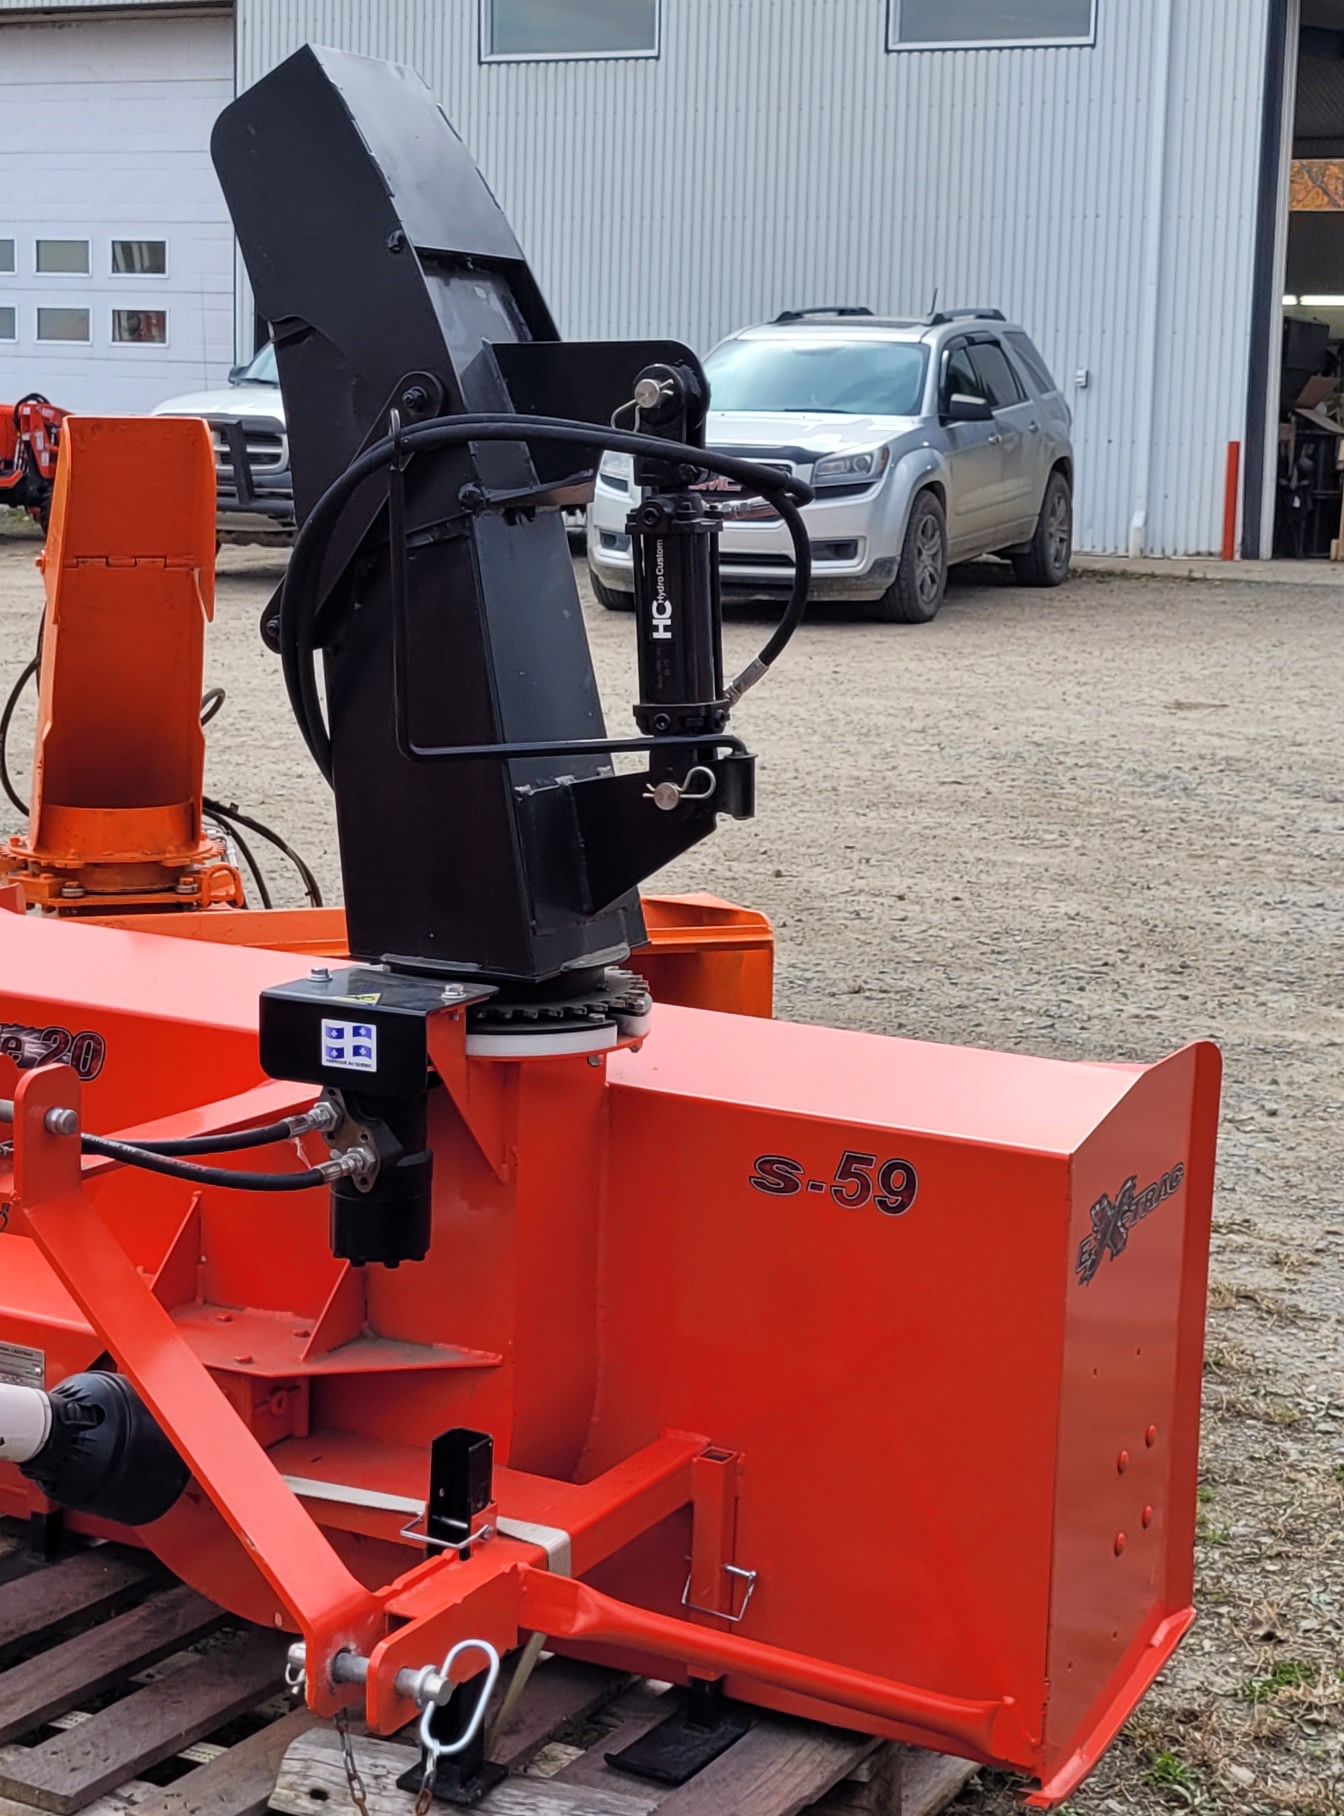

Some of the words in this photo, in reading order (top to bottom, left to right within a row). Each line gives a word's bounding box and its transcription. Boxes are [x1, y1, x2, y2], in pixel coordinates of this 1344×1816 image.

[656, 539, 664, 576] Custom
[656, 575, 668, 604] Hydro
[651, 600, 673, 640] HC
[35, 1025, 106, 1082] 20
[748, 1150, 920, 1217] S-59
